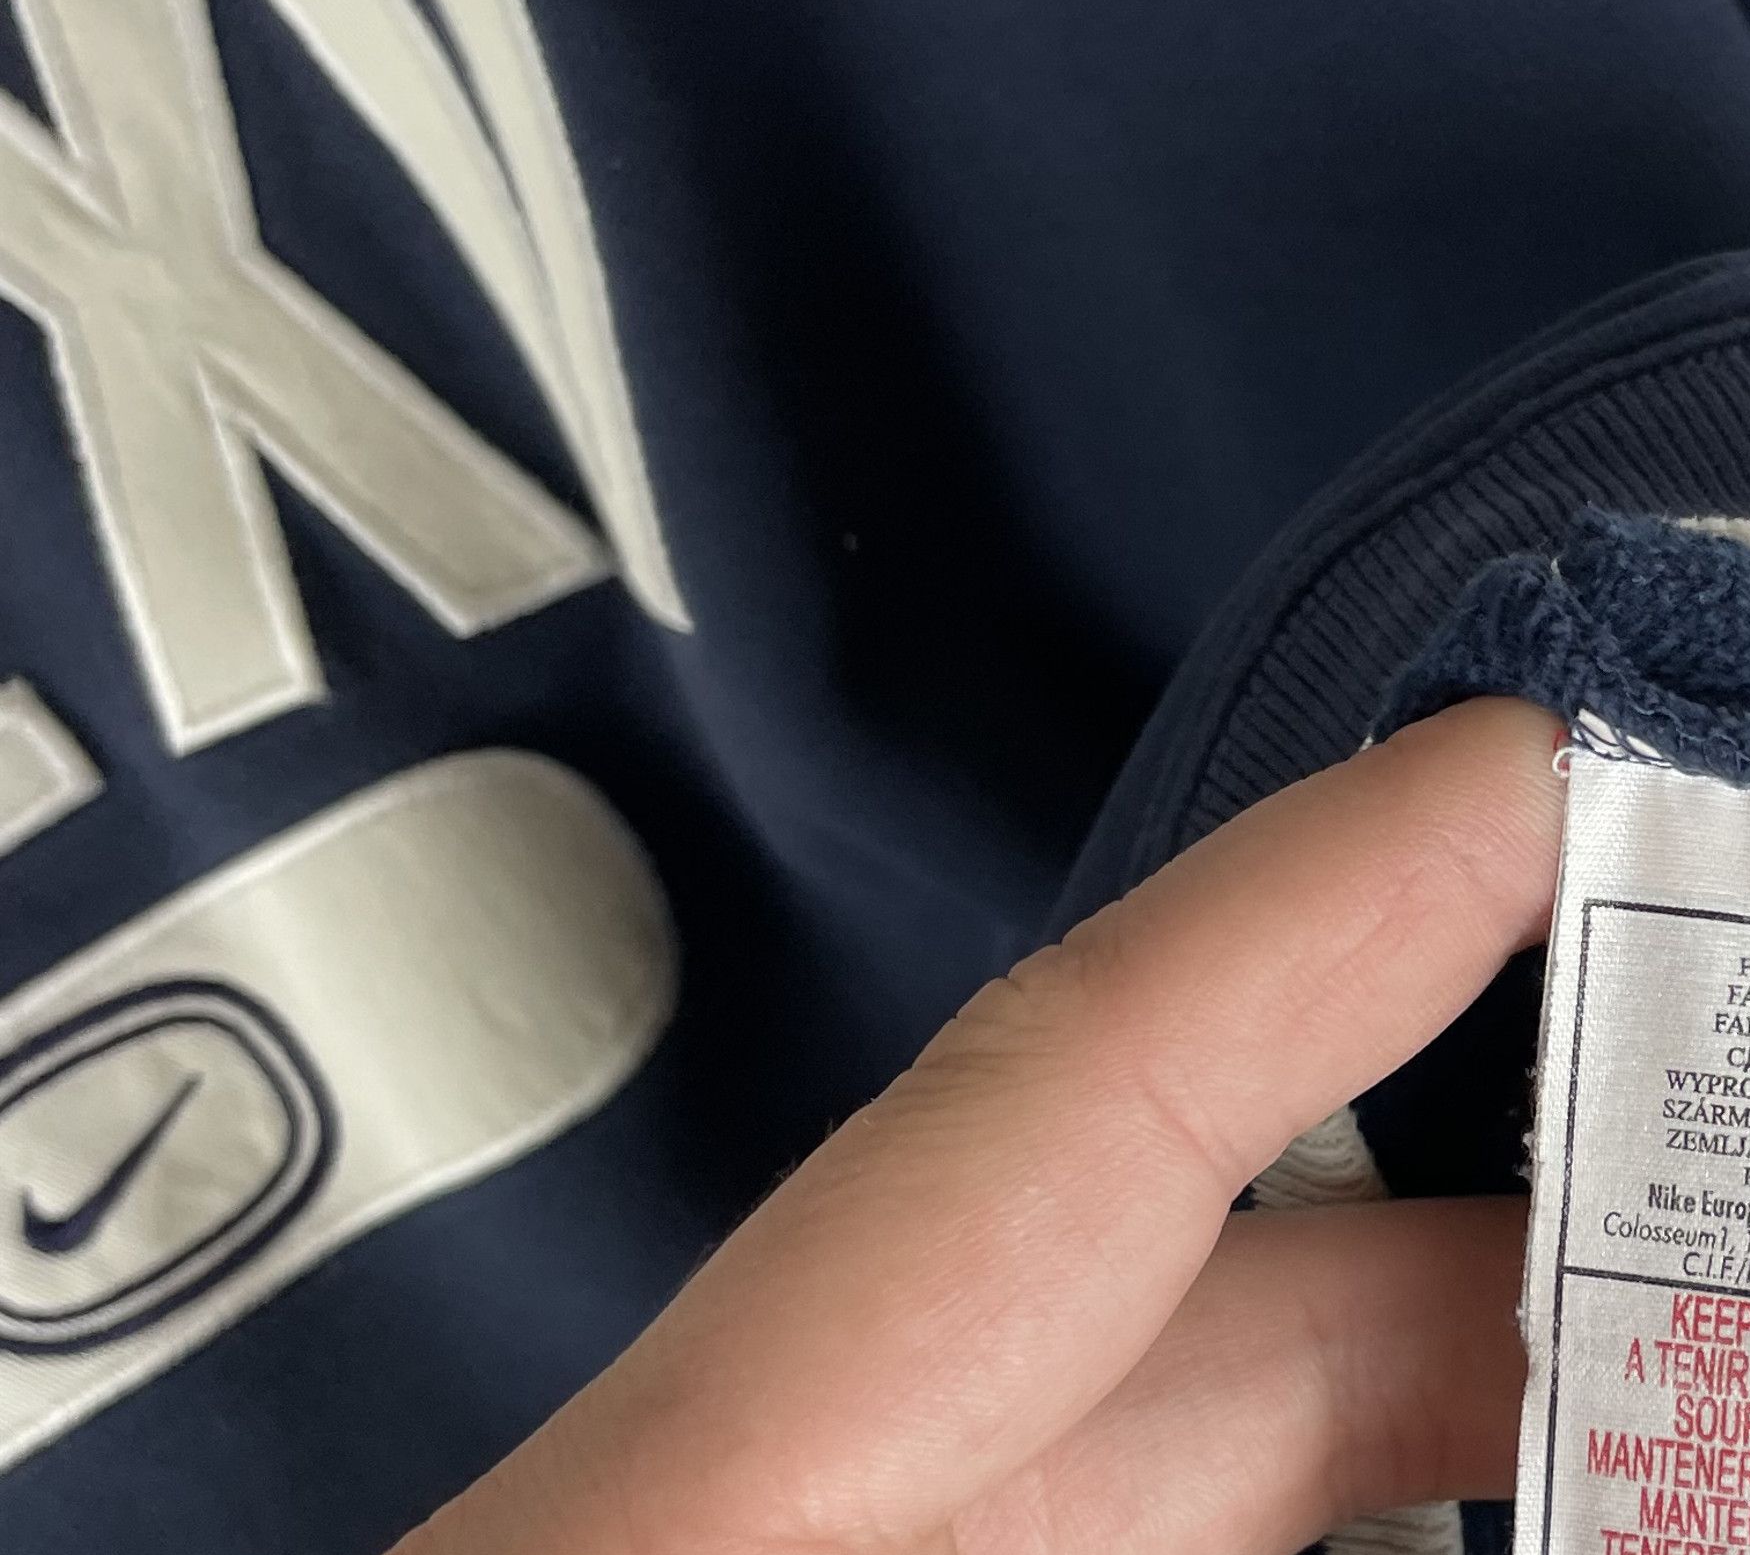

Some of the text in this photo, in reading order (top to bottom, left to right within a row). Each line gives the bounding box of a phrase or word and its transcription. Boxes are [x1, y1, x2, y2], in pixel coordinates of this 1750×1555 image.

[1648, 1183, 1697, 1213] Nike
[1603, 1211, 1735, 1254] Colosseum1,
[1625, 1337, 1645, 1384] A
[1654, 1340, 1749, 1399] TENIR
